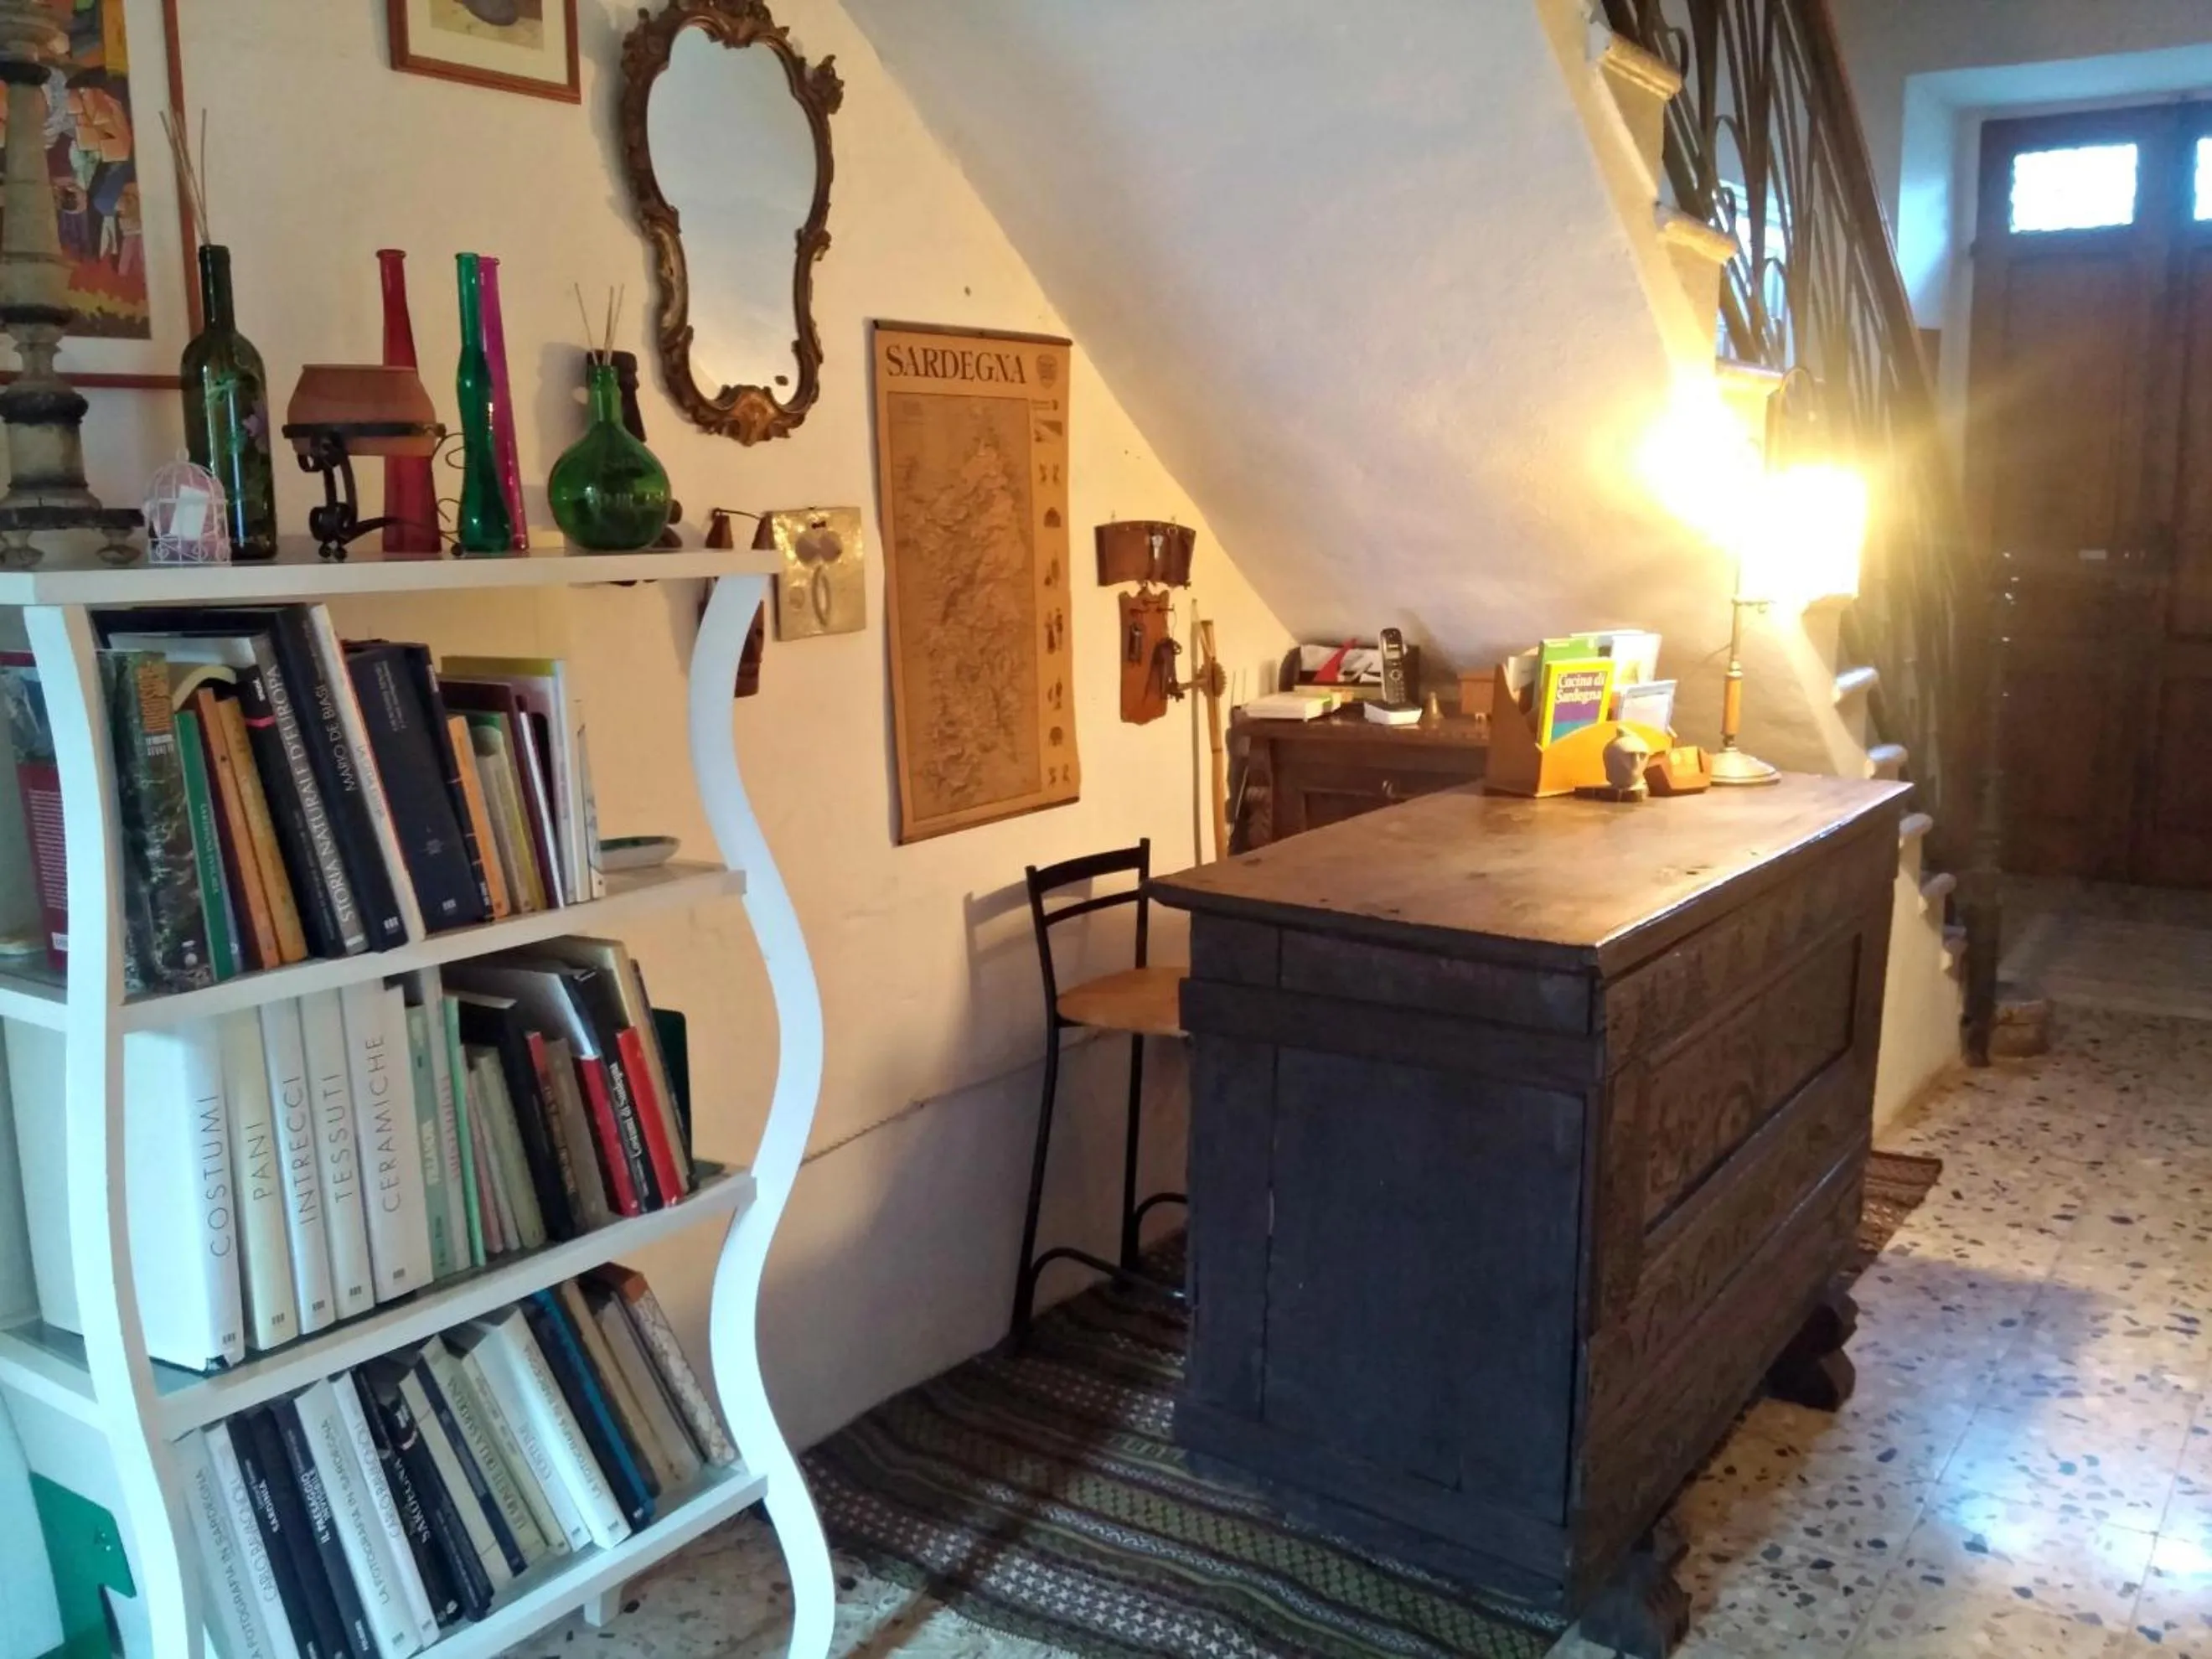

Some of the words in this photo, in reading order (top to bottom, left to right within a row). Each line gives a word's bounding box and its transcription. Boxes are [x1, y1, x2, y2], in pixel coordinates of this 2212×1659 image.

[886, 344, 1026, 384] SARDEGNA
[313, 683, 335, 720] BIASI
[1556, 688, 1602, 705] Sardegna
[1594, 670, 1605, 686] di
[262, 664, 307, 760] D'EUROPA
[324, 719, 343, 742] DE
[331, 742, 358, 792] MARIO
[292, 763, 337, 856] NATURALE
[323, 859, 355, 923] STORIA
[605, 1062, 632, 1107] Sardegna
[283, 1075, 318, 1225] INTRECCI
[323, 1073, 352, 1203] TESSUTI
[365, 1035, 401, 1213] CERAMICHE
[620, 1117, 644, 1158] Costumi
[196, 1095, 230, 1257] COSTUMI
[246, 1123, 273, 1201] PANI
[318, 1419, 354, 1491] SARDEGNA
[193, 1469, 226, 1546] SARDEGNA
[257, 1479, 282, 1532] SARDINIA
[298, 1471, 328, 1532] PAESAGGIO
[218, 1547, 232, 1563] IN
[346, 1507, 387, 1585] FOTOGRAFIA
[223, 1563, 259, 1647] FOTOGRAFIA
[375, 1585, 391, 1605] LA
